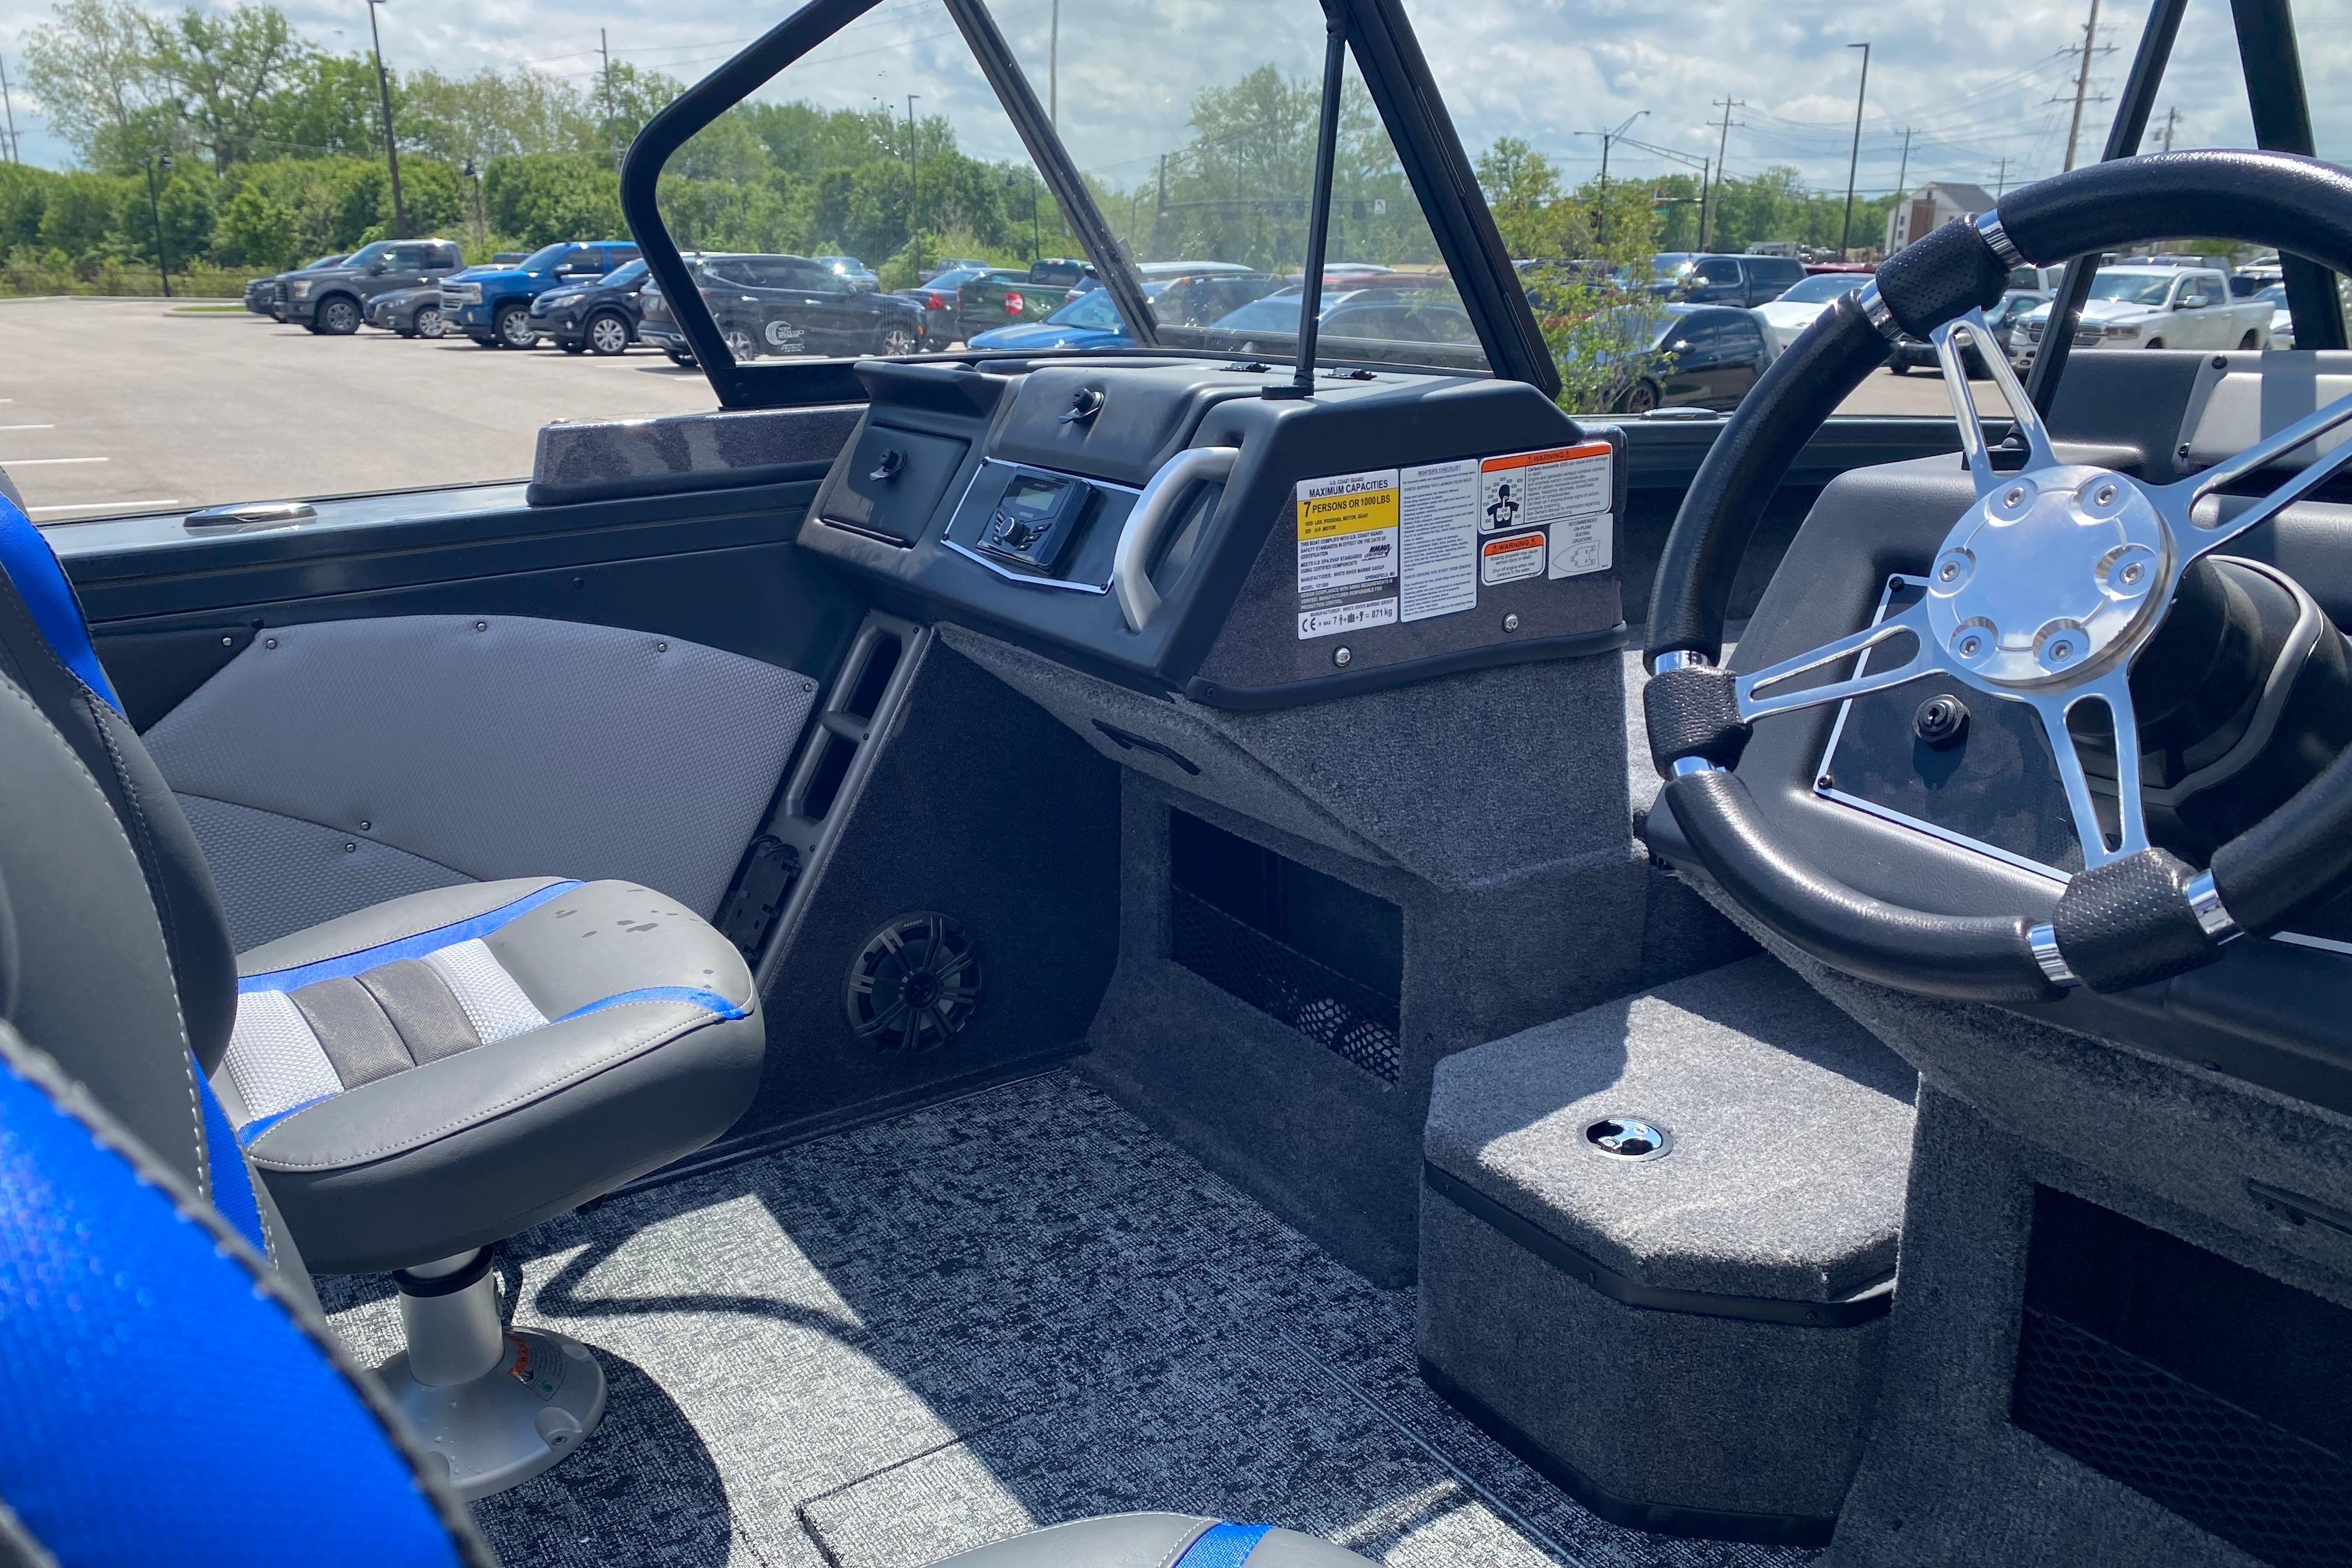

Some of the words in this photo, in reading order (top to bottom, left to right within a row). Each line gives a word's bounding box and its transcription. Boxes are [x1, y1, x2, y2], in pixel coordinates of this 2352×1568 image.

[1534, 452, 1564, 461] WARNING
[1309, 485, 1343, 498] MAXIMUM
[1346, 479, 1388, 493] CAPACITIES
[1304, 501, 1311, 517] 7
[1312, 501, 1346, 513] PERSONS
[1349, 499, 1359, 508] OR
[1362, 496, 1376, 506] 1000
[1377, 494, 1390, 504] LBS
[1569, 517, 1597, 526] RECOMMENDED
[1499, 540, 1529, 550] WARNING
[1332, 560, 1357, 568] COMPONENTS
[1315, 587, 1338, 596] COMPLIANCE
[1349, 587, 1374, 596] RESPONSIBLE
[1333, 616, 1337, 625] 7
[1371, 609, 1382, 618] 871
[1384, 607, 1392, 617] kg
